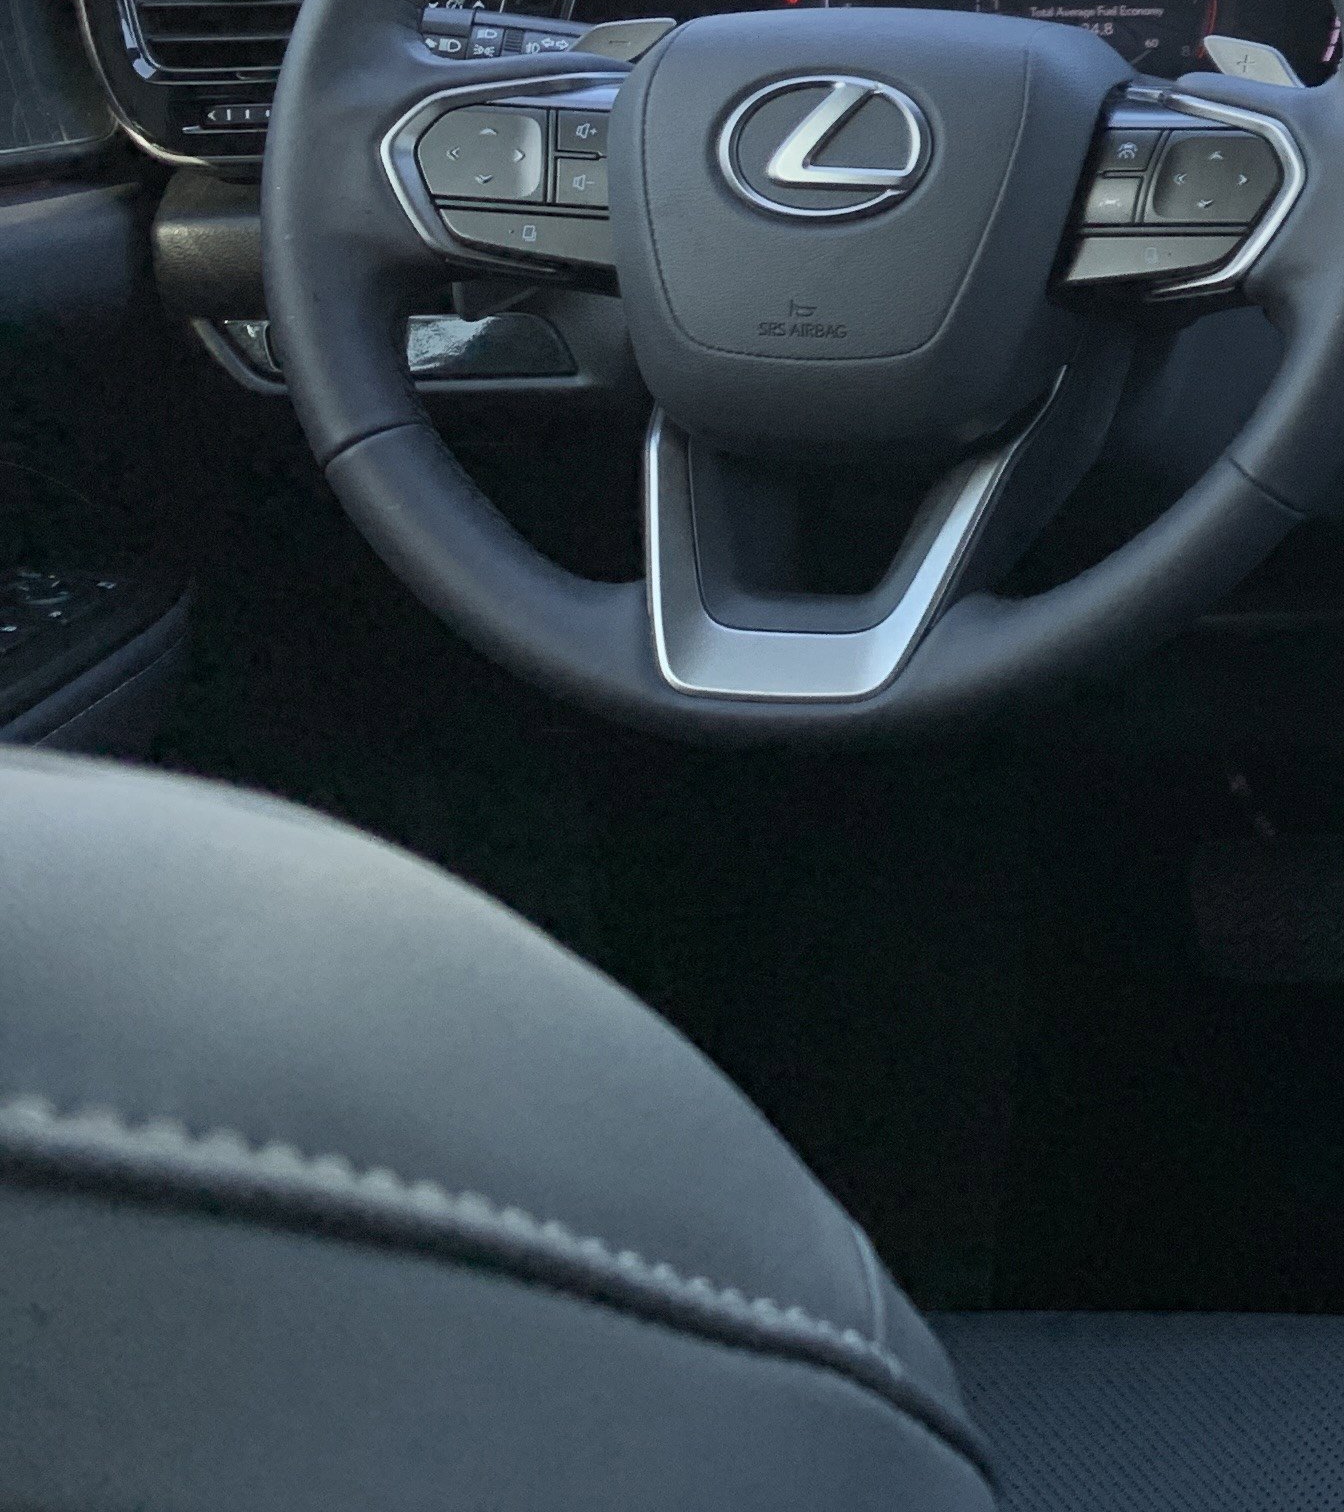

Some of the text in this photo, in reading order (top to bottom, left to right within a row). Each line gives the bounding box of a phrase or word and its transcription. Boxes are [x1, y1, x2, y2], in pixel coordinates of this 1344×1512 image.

[1031, 5, 1164, 19] Total Average Fuel Economy
[757, 322, 848, 338] SRS AIRBAG
